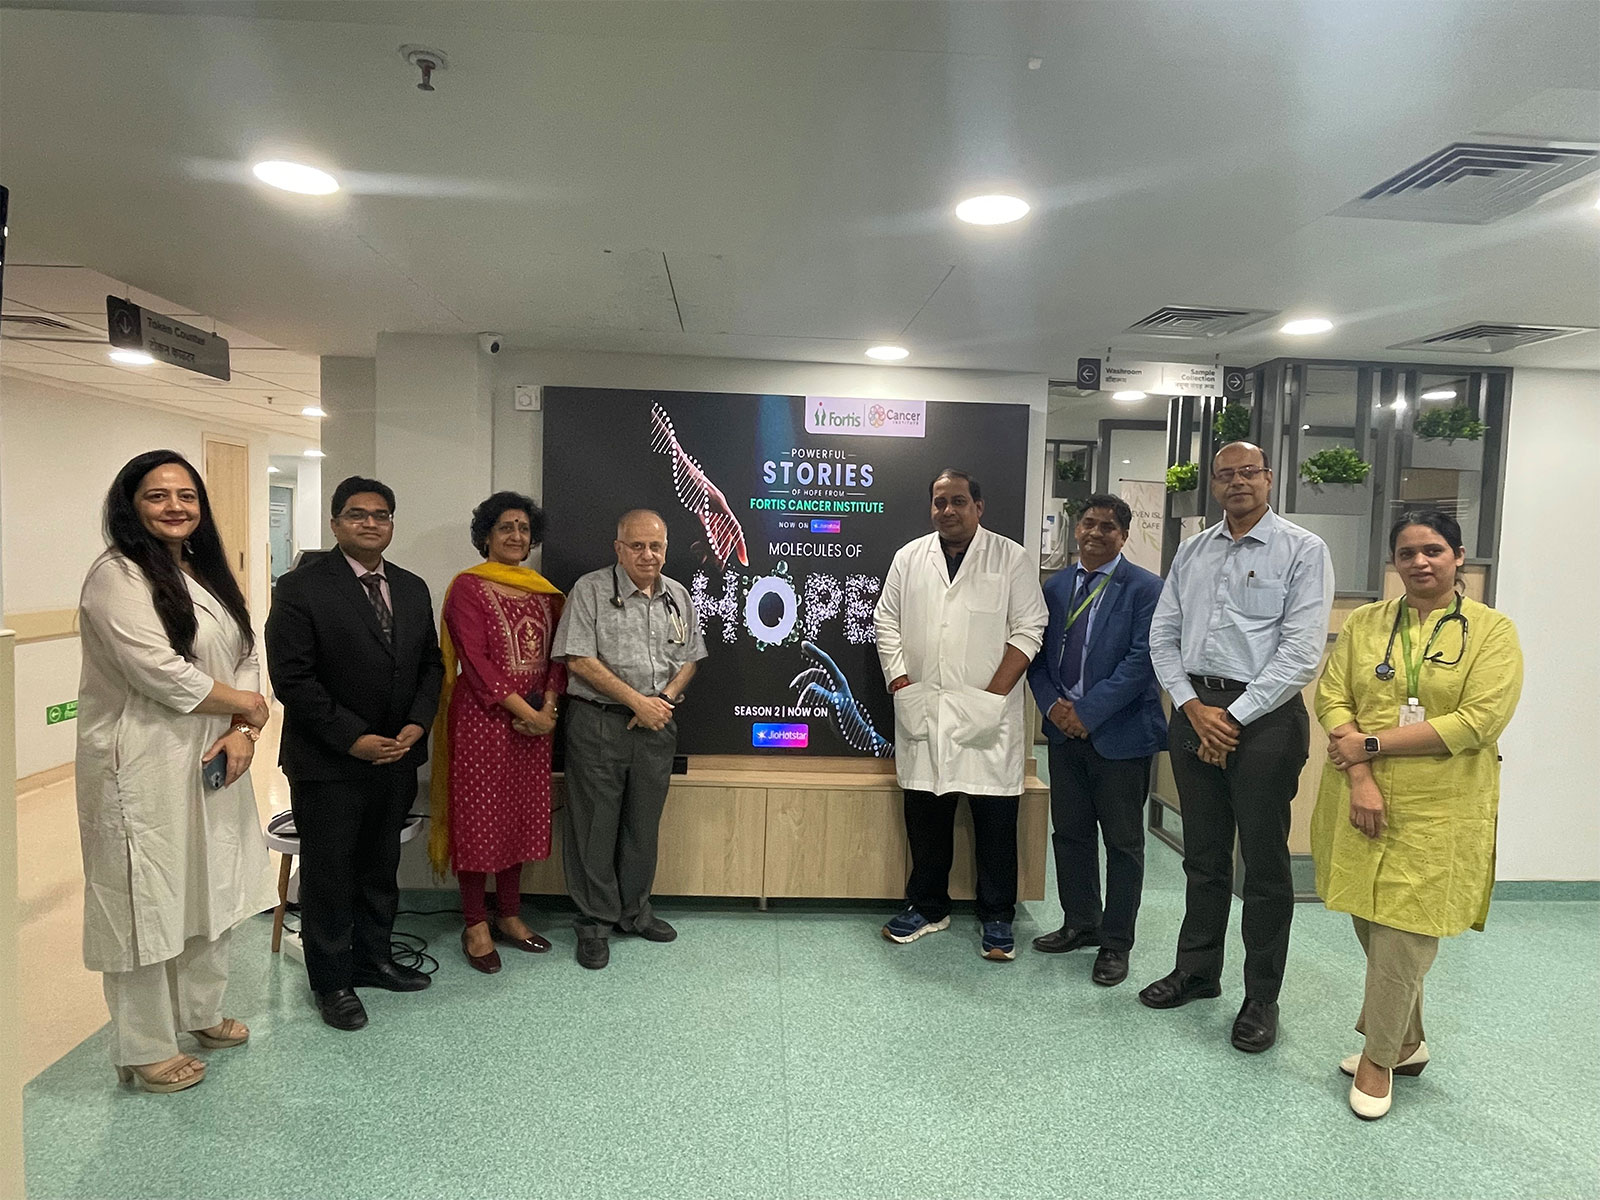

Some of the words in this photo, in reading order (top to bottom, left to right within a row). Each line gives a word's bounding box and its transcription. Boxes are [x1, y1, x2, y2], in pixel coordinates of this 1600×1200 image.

[147, 317, 173, 335] Token
[1105, 367, 1143, 375] Washroom
[1190, 368, 1216, 377] Sample
[1181, 373, 1216, 382] Collection
[829, 411, 861, 428] Fortis
[886, 409, 921, 421] Cancer
[791, 448, 846, 460] POWERFUL
[762, 460, 874, 488] STORIES
[791, 488, 801, 496] OF
[803, 489, 822, 497] HOPE
[824, 489, 845, 498] FROM
[750, 498, 787, 511] FORTIS
[788, 499, 832, 512] CANCER
[833, 501, 884, 513] INSTITUTE
[778, 520, 796, 529] NOW
[798, 521, 809, 529] ON
[1141, 521, 1160, 530] CAFE
[769, 542, 842, 557] MOLECULES
[845, 544, 863, 558] OF
[691, 568, 881, 647] HOPE
[734, 705, 772, 717] SEASON
[774, 706, 780, 717] 2
[787, 706, 811, 717] NOW
[813, 707, 828, 718] ON
[768, 730, 807, 740] JioHotstar
